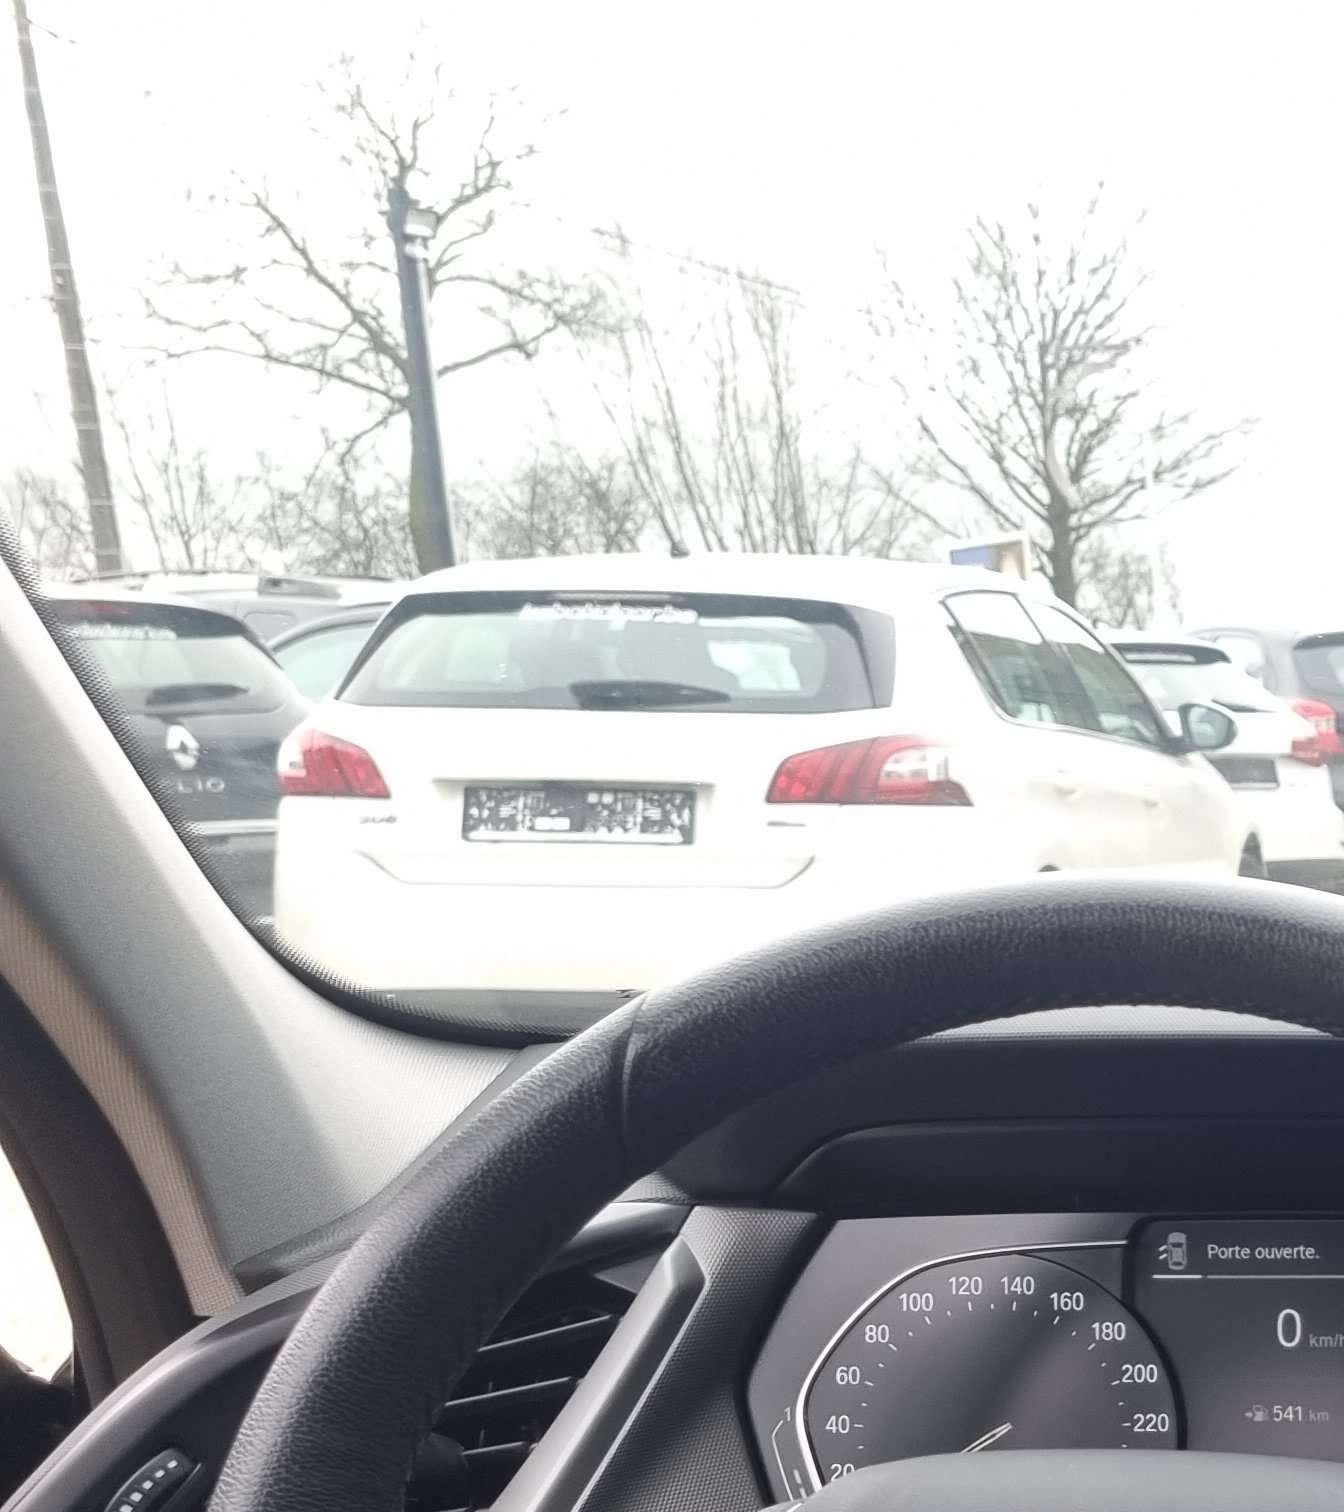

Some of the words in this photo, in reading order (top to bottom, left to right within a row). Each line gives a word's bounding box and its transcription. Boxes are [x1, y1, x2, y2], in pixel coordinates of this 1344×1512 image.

[1207, 1243, 1251, 1260] Porte
[1254, 1245, 1320, 1260] ouverte.
[948, 1276, 983, 1296] 120
[1000, 1275, 1035, 1296] 140
[898, 1292, 934, 1312] 100
[1049, 1291, 1084, 1311] 160
[864, 1324, 890, 1344] 80
[1091, 1321, 1126, 1341] 180
[1276, 1308, 1302, 1348] 0
[835, 1366, 861, 1385] 60
[1121, 1363, 1158, 1384] 200
[1133, 1413, 1170, 1433] 220
[1273, 1405, 1302, 1422] 541
[1308, 1409, 1329, 1422] km
[825, 1414, 850, 1434] 40
